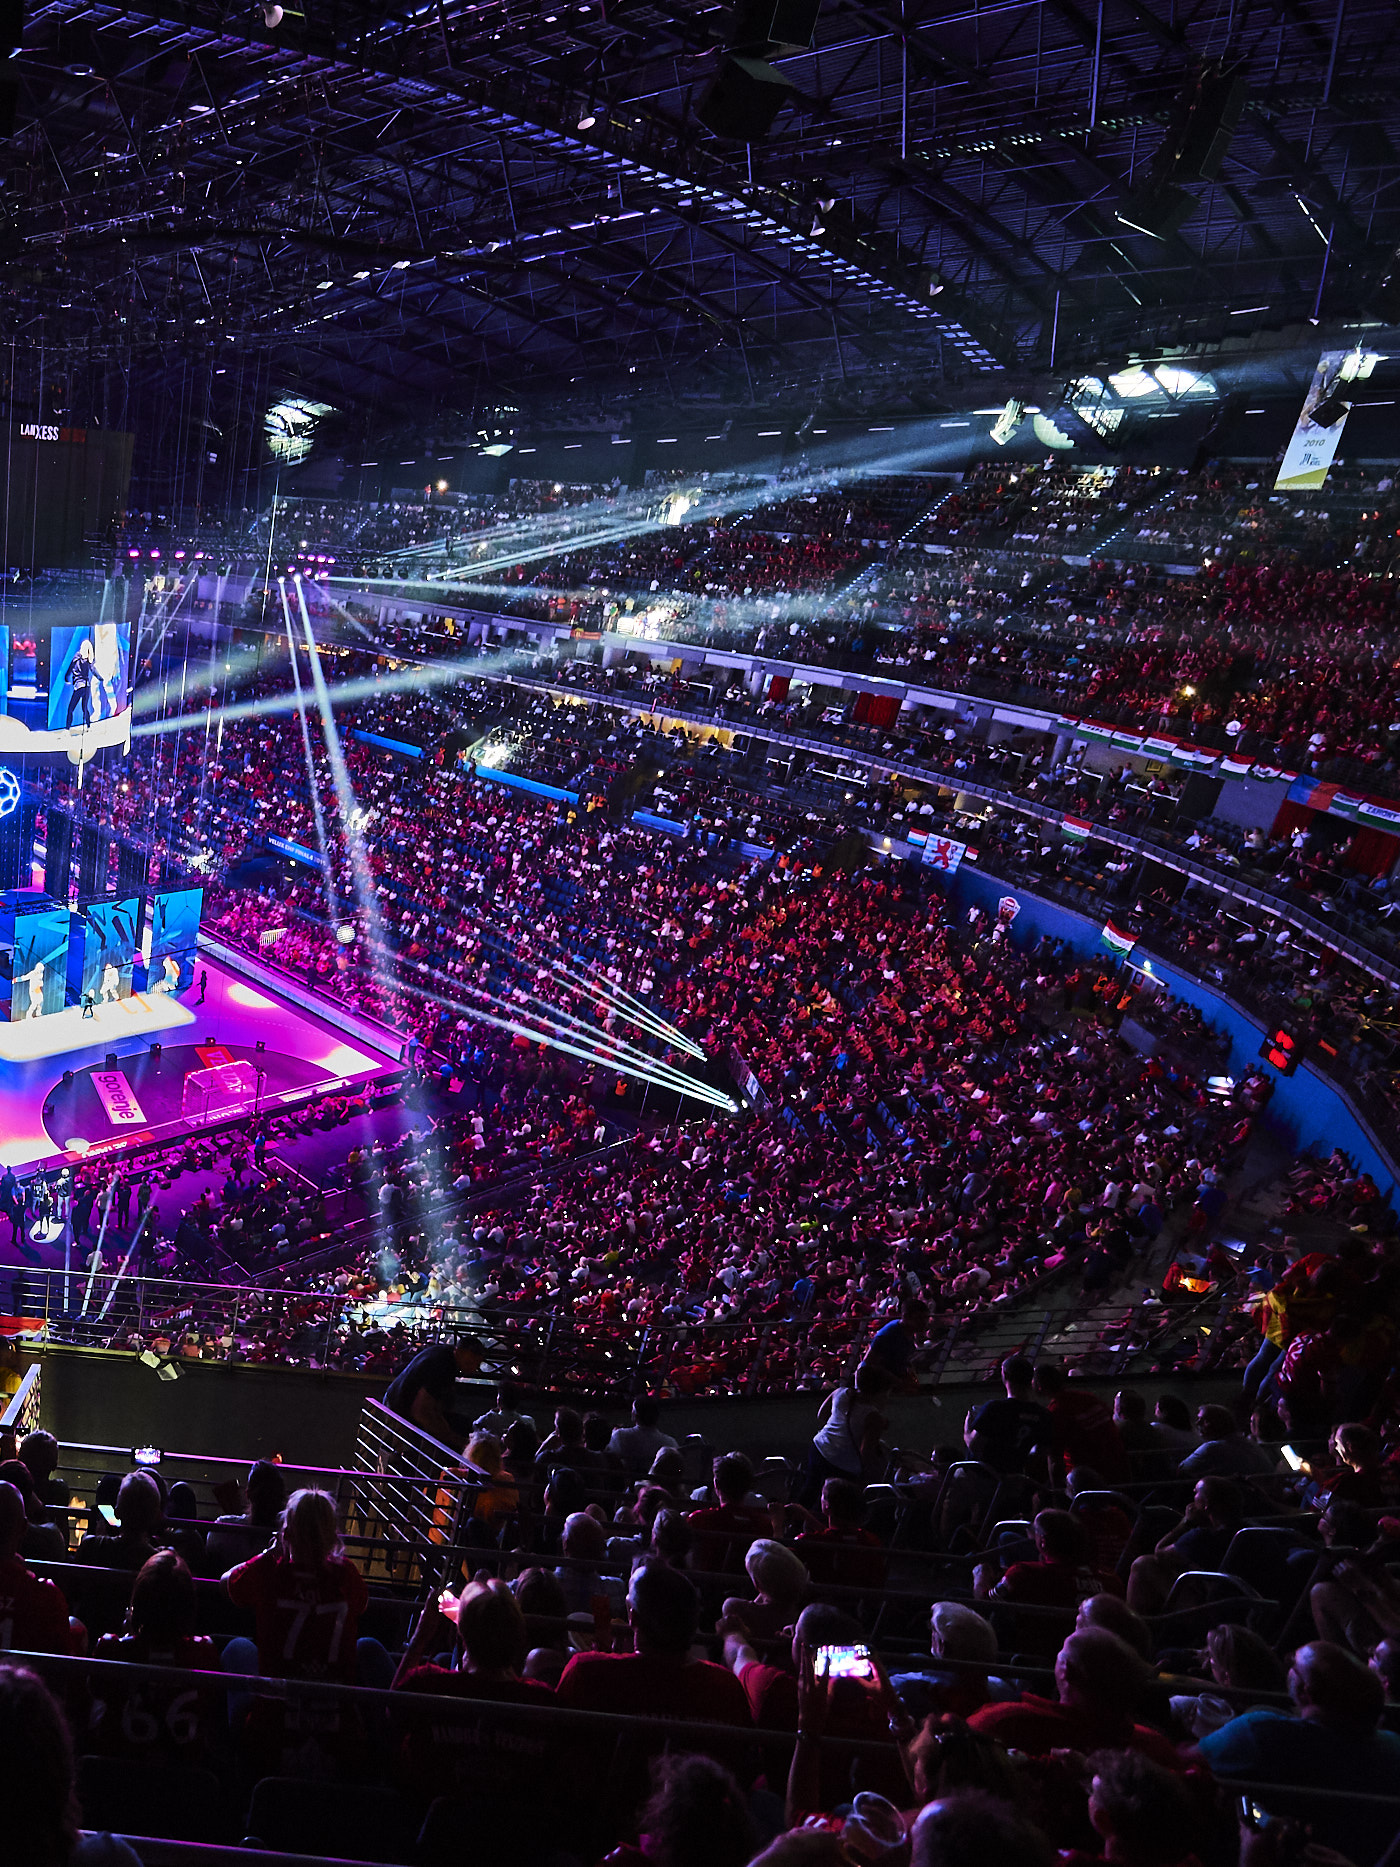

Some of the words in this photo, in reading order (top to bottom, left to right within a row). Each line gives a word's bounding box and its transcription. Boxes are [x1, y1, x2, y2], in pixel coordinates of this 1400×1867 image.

[20, 423, 59, 441] LANXESS
[1303, 439, 1326, 447] 2010
[98, 1075, 138, 1119] gorenje
[276, 1599, 348, 1664] 77
[121, 1689, 200, 1745] 66
